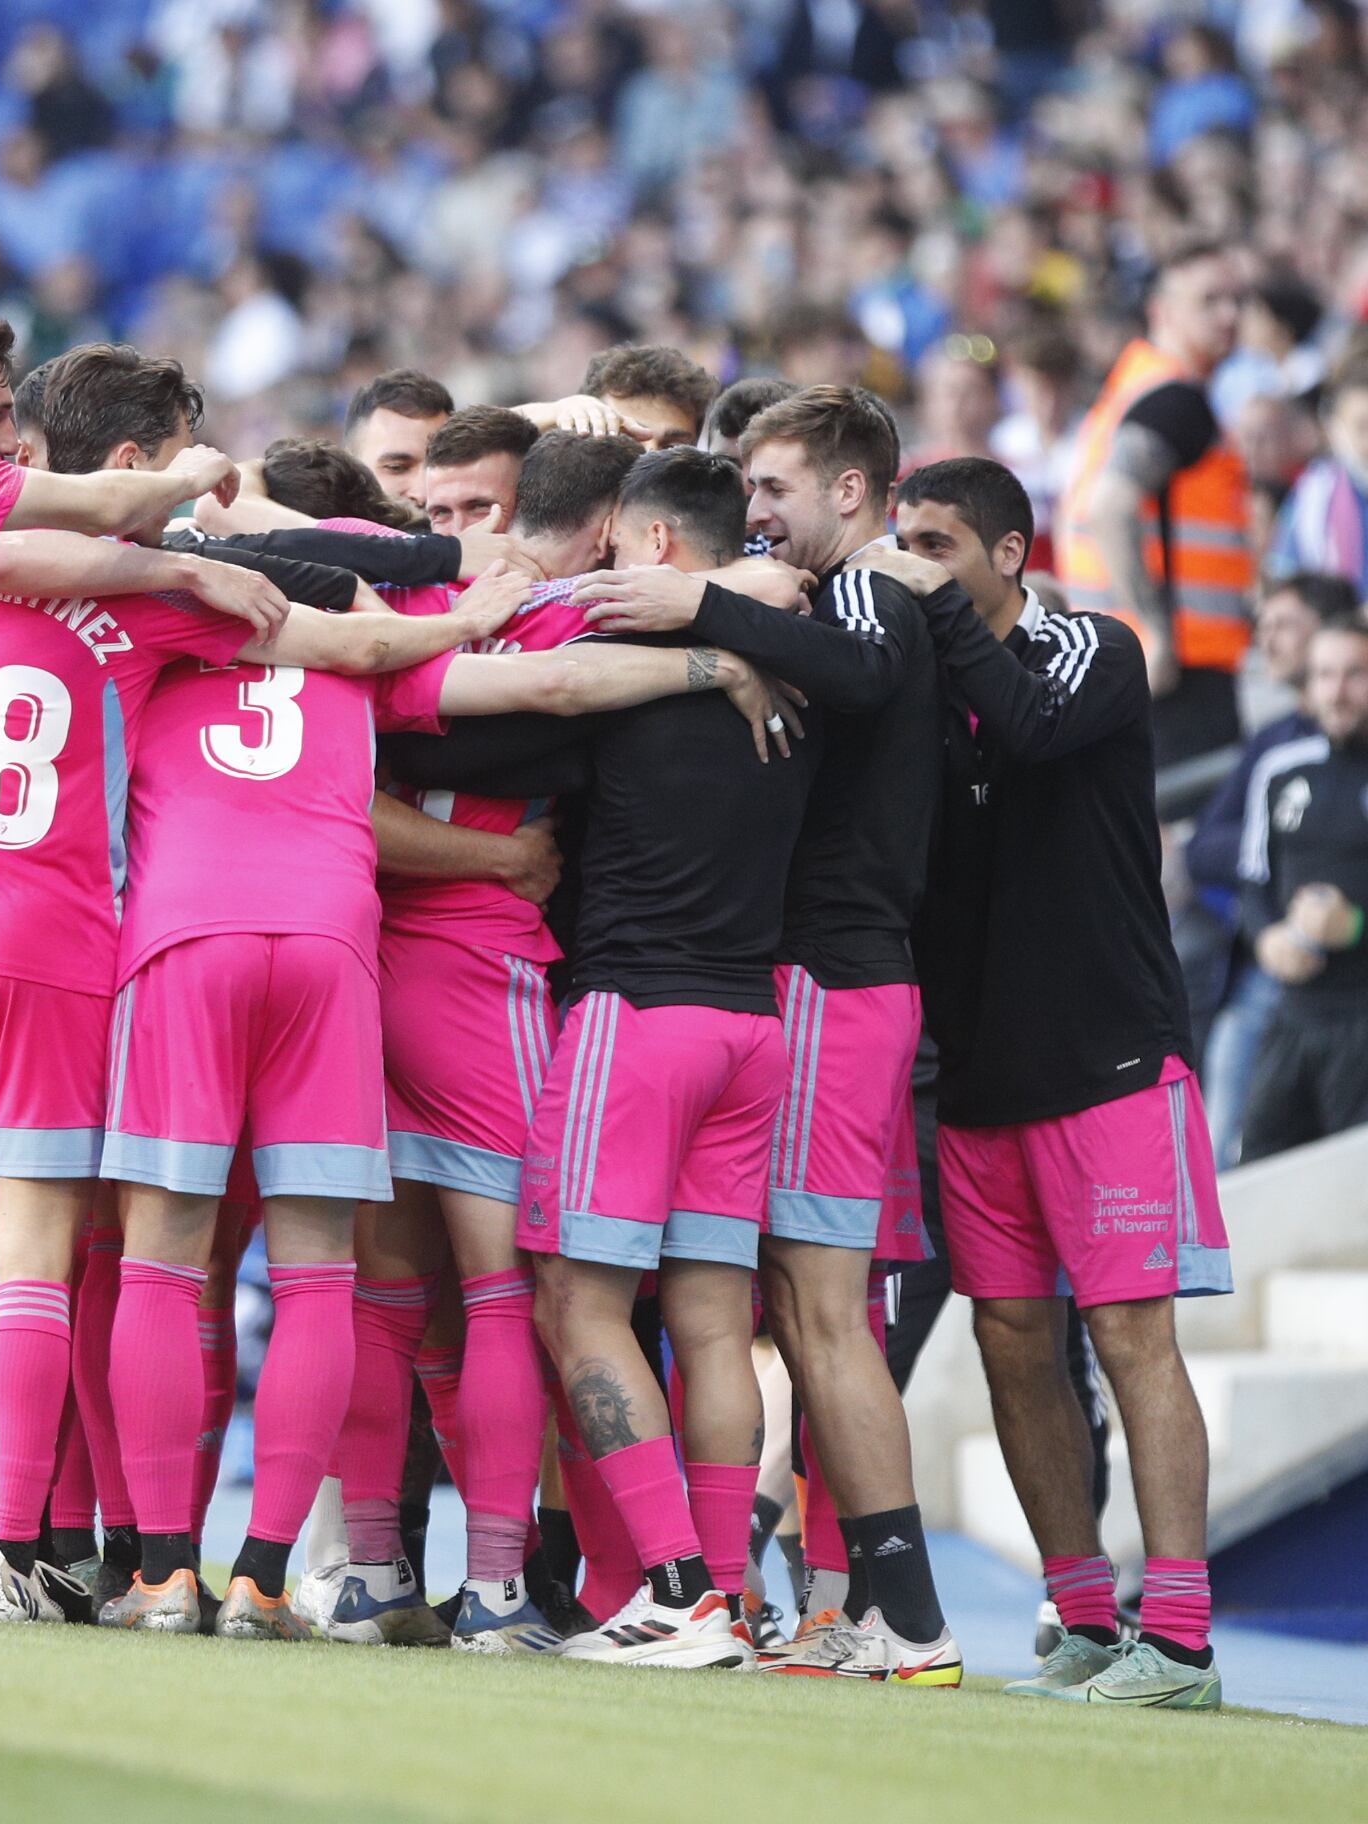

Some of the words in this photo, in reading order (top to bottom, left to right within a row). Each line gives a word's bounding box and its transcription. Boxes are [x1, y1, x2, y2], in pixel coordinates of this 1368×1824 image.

[199, 659, 306, 782] 3
[1092, 1200, 1174, 1218] Universidad
[1092, 1219, 1110, 1235] de
[1113, 1218, 1169, 1233] Navarra
